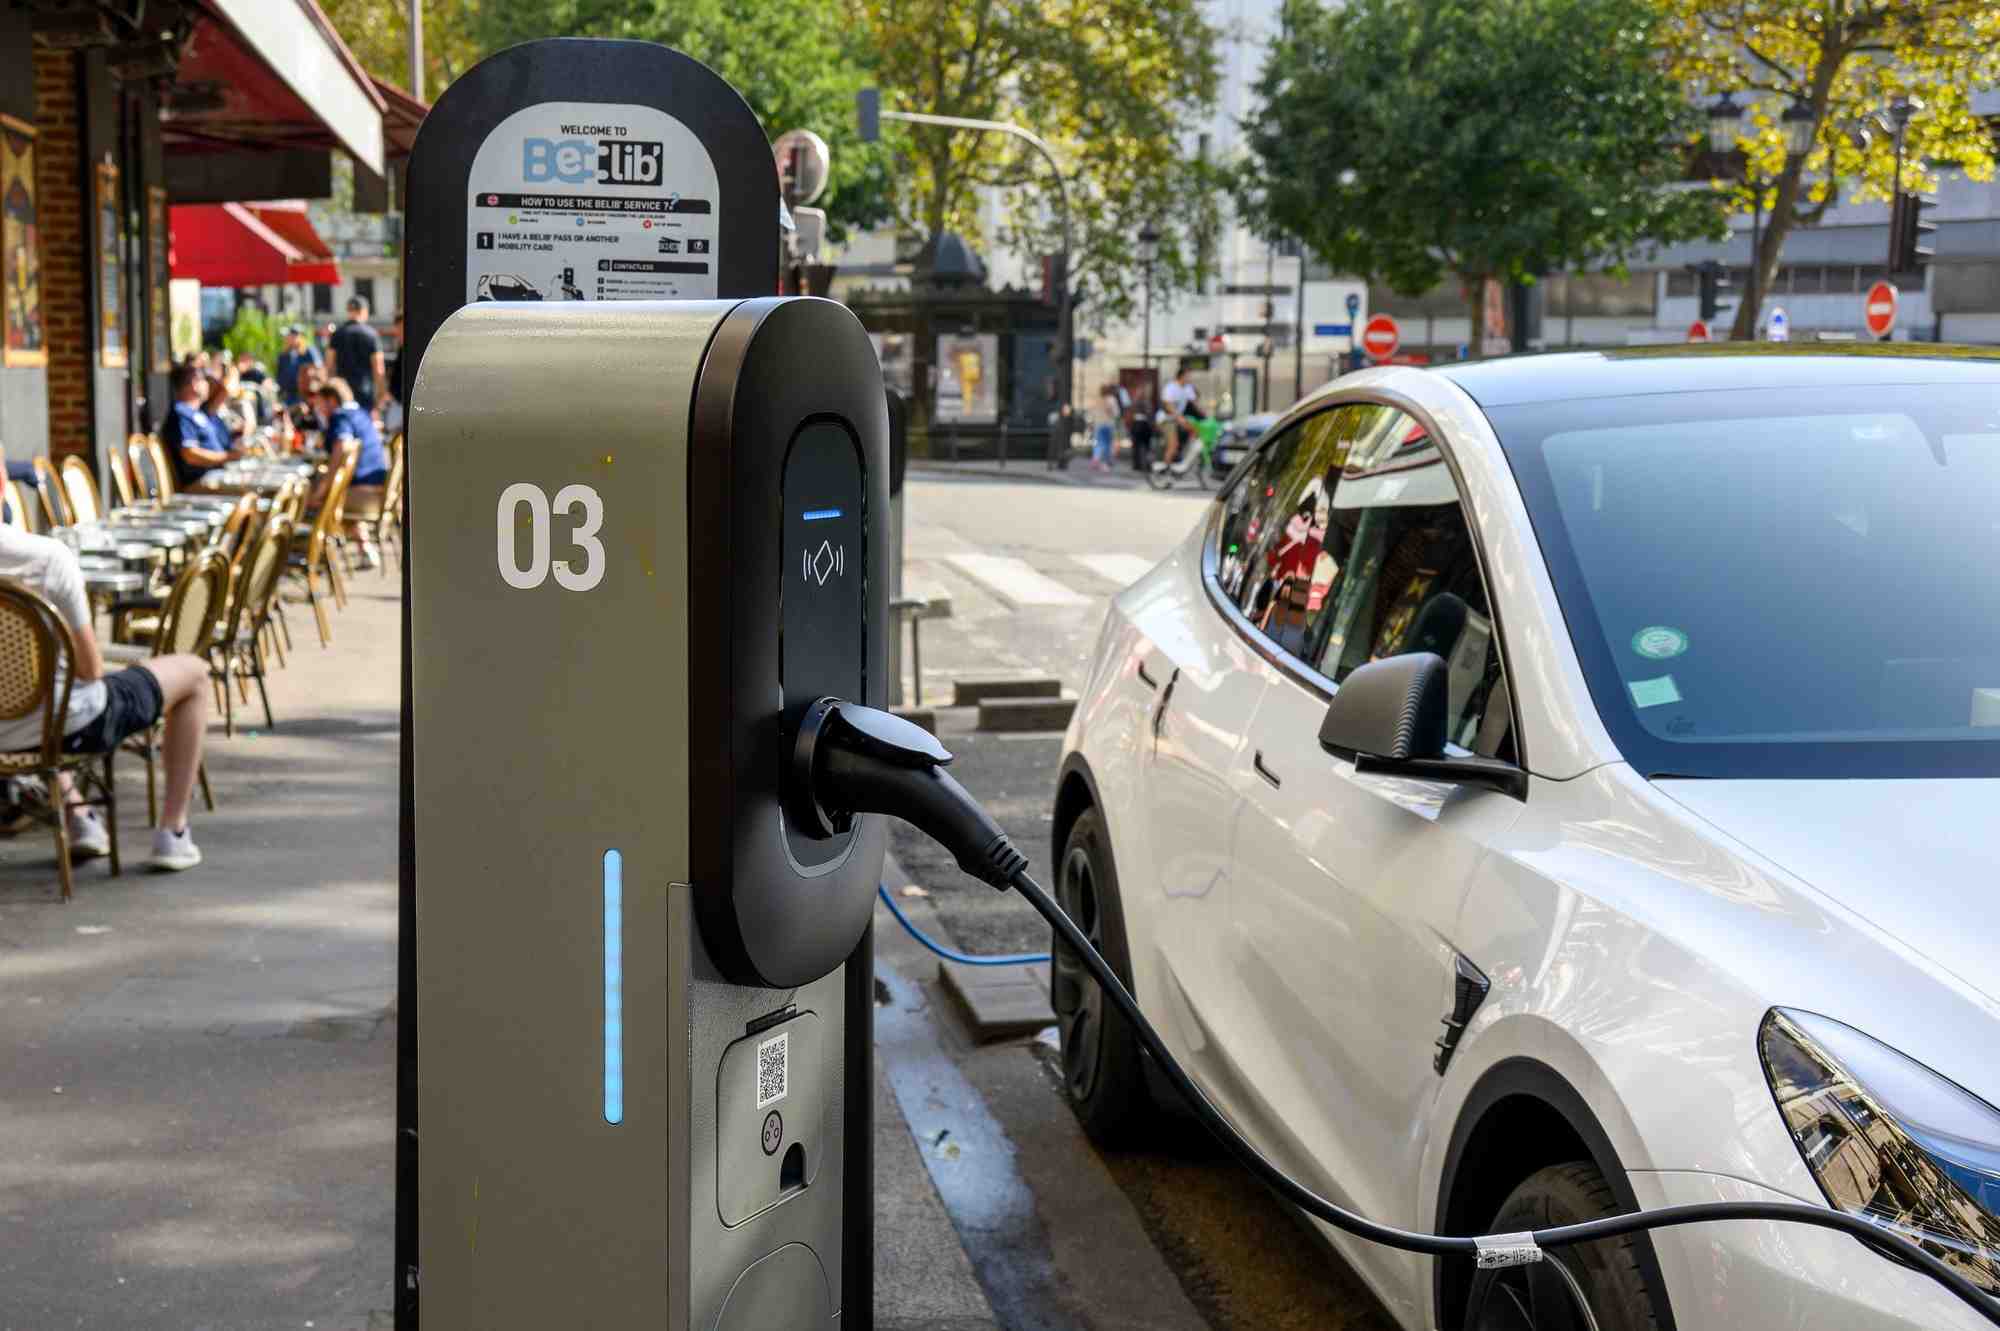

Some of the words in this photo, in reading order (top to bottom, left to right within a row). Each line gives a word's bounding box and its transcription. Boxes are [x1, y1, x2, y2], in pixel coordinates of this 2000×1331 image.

[560, 124, 612, 136] WELCOME
[614, 126, 628, 137] TO
[521, 197, 543, 206] HOW
[544, 198, 556, 207] TO
[557, 198, 574, 208] USE
[576, 199, 593, 208] THE
[624, 200, 660, 210] SERVICE
[502, 233, 521, 241] HAVE
[523, 233, 529, 241] A
[554, 234, 572, 242] PASS
[586, 235, 620, 243] ANOTHER
[498, 242, 531, 251] MOBILITY
[534, 243, 553, 251] CARD
[497, 482, 606, 592] 03
